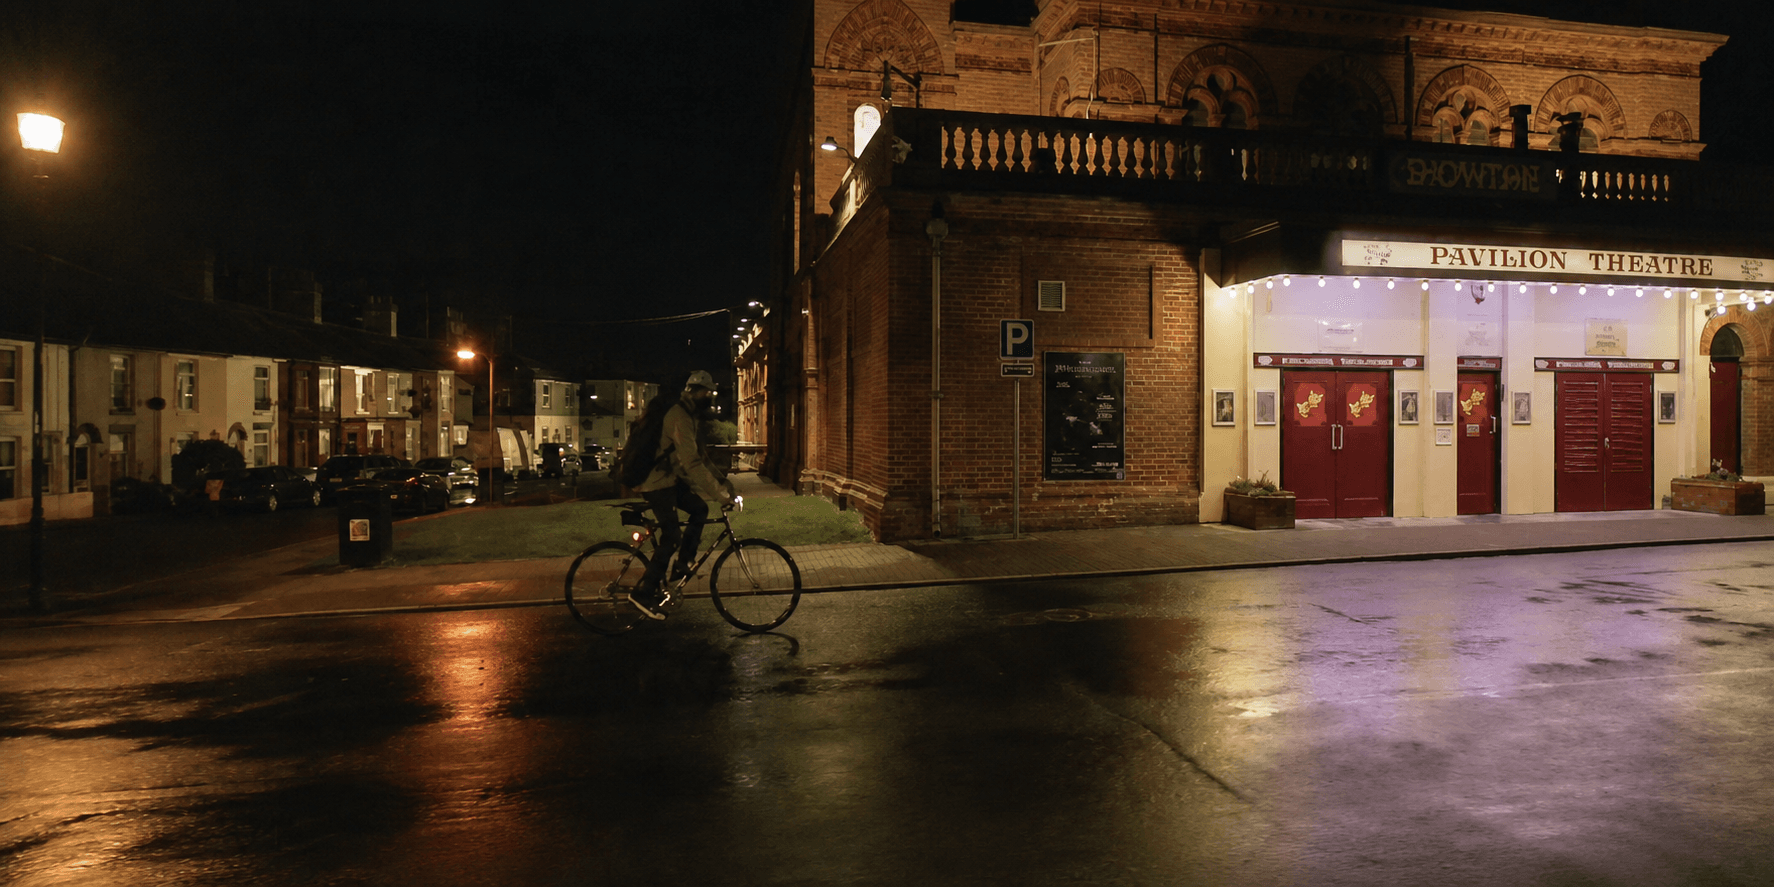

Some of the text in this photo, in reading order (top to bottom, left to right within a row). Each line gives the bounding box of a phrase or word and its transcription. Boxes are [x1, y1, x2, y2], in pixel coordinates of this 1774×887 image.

[1430, 246, 1567, 270] PAVILION
[1589, 252, 1713, 276] THEATRE
[1007, 322, 1029, 355] P
